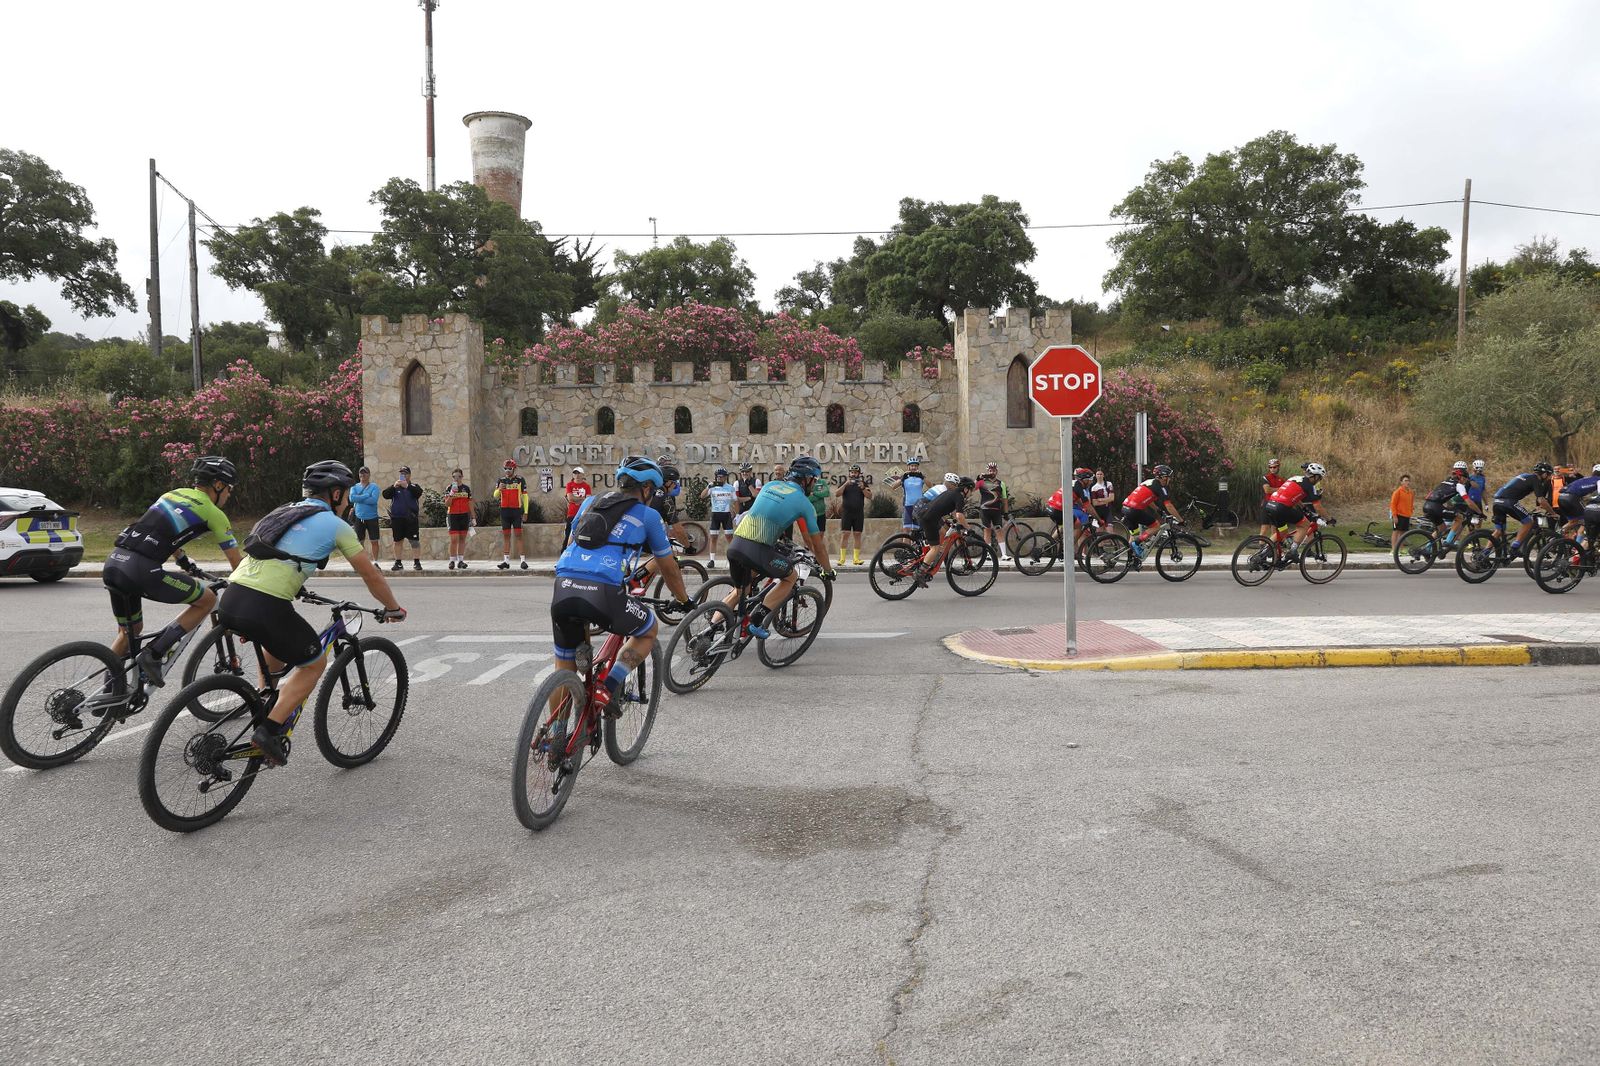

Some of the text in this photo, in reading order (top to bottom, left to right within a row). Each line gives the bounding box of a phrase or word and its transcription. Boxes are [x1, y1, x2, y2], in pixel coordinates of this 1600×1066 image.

[1035, 373, 1096, 391] STOP
[685, 443, 721, 464] DE
[730, 443, 768, 464] LA
[774, 441, 931, 464] FRONTERA
[820, 471, 873, 488] Espa
